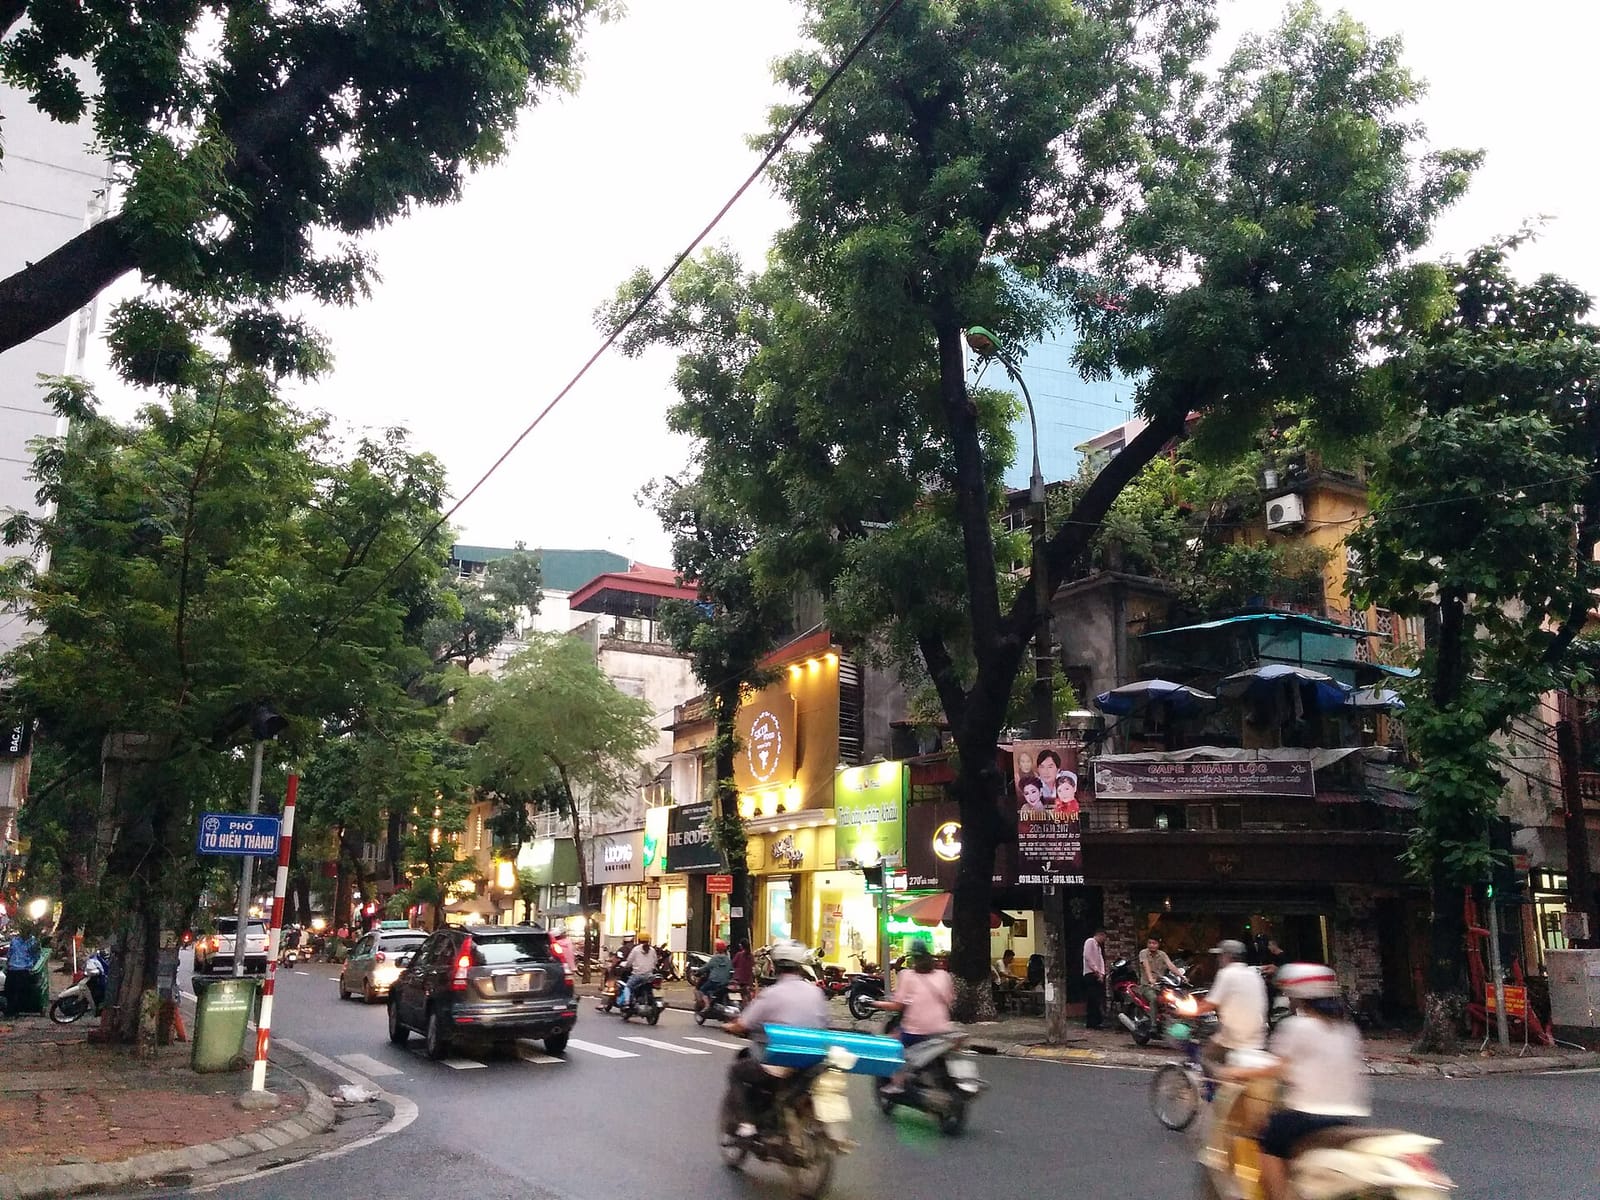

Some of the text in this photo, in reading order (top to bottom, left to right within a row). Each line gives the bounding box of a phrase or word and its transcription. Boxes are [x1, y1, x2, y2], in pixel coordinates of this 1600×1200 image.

[9, 733, 20, 752] BAC
[229, 820, 255, 831] PHỐ
[205, 830, 274, 849] TÔ HIẾN THÀNH
[668, 831, 683, 847] THE
